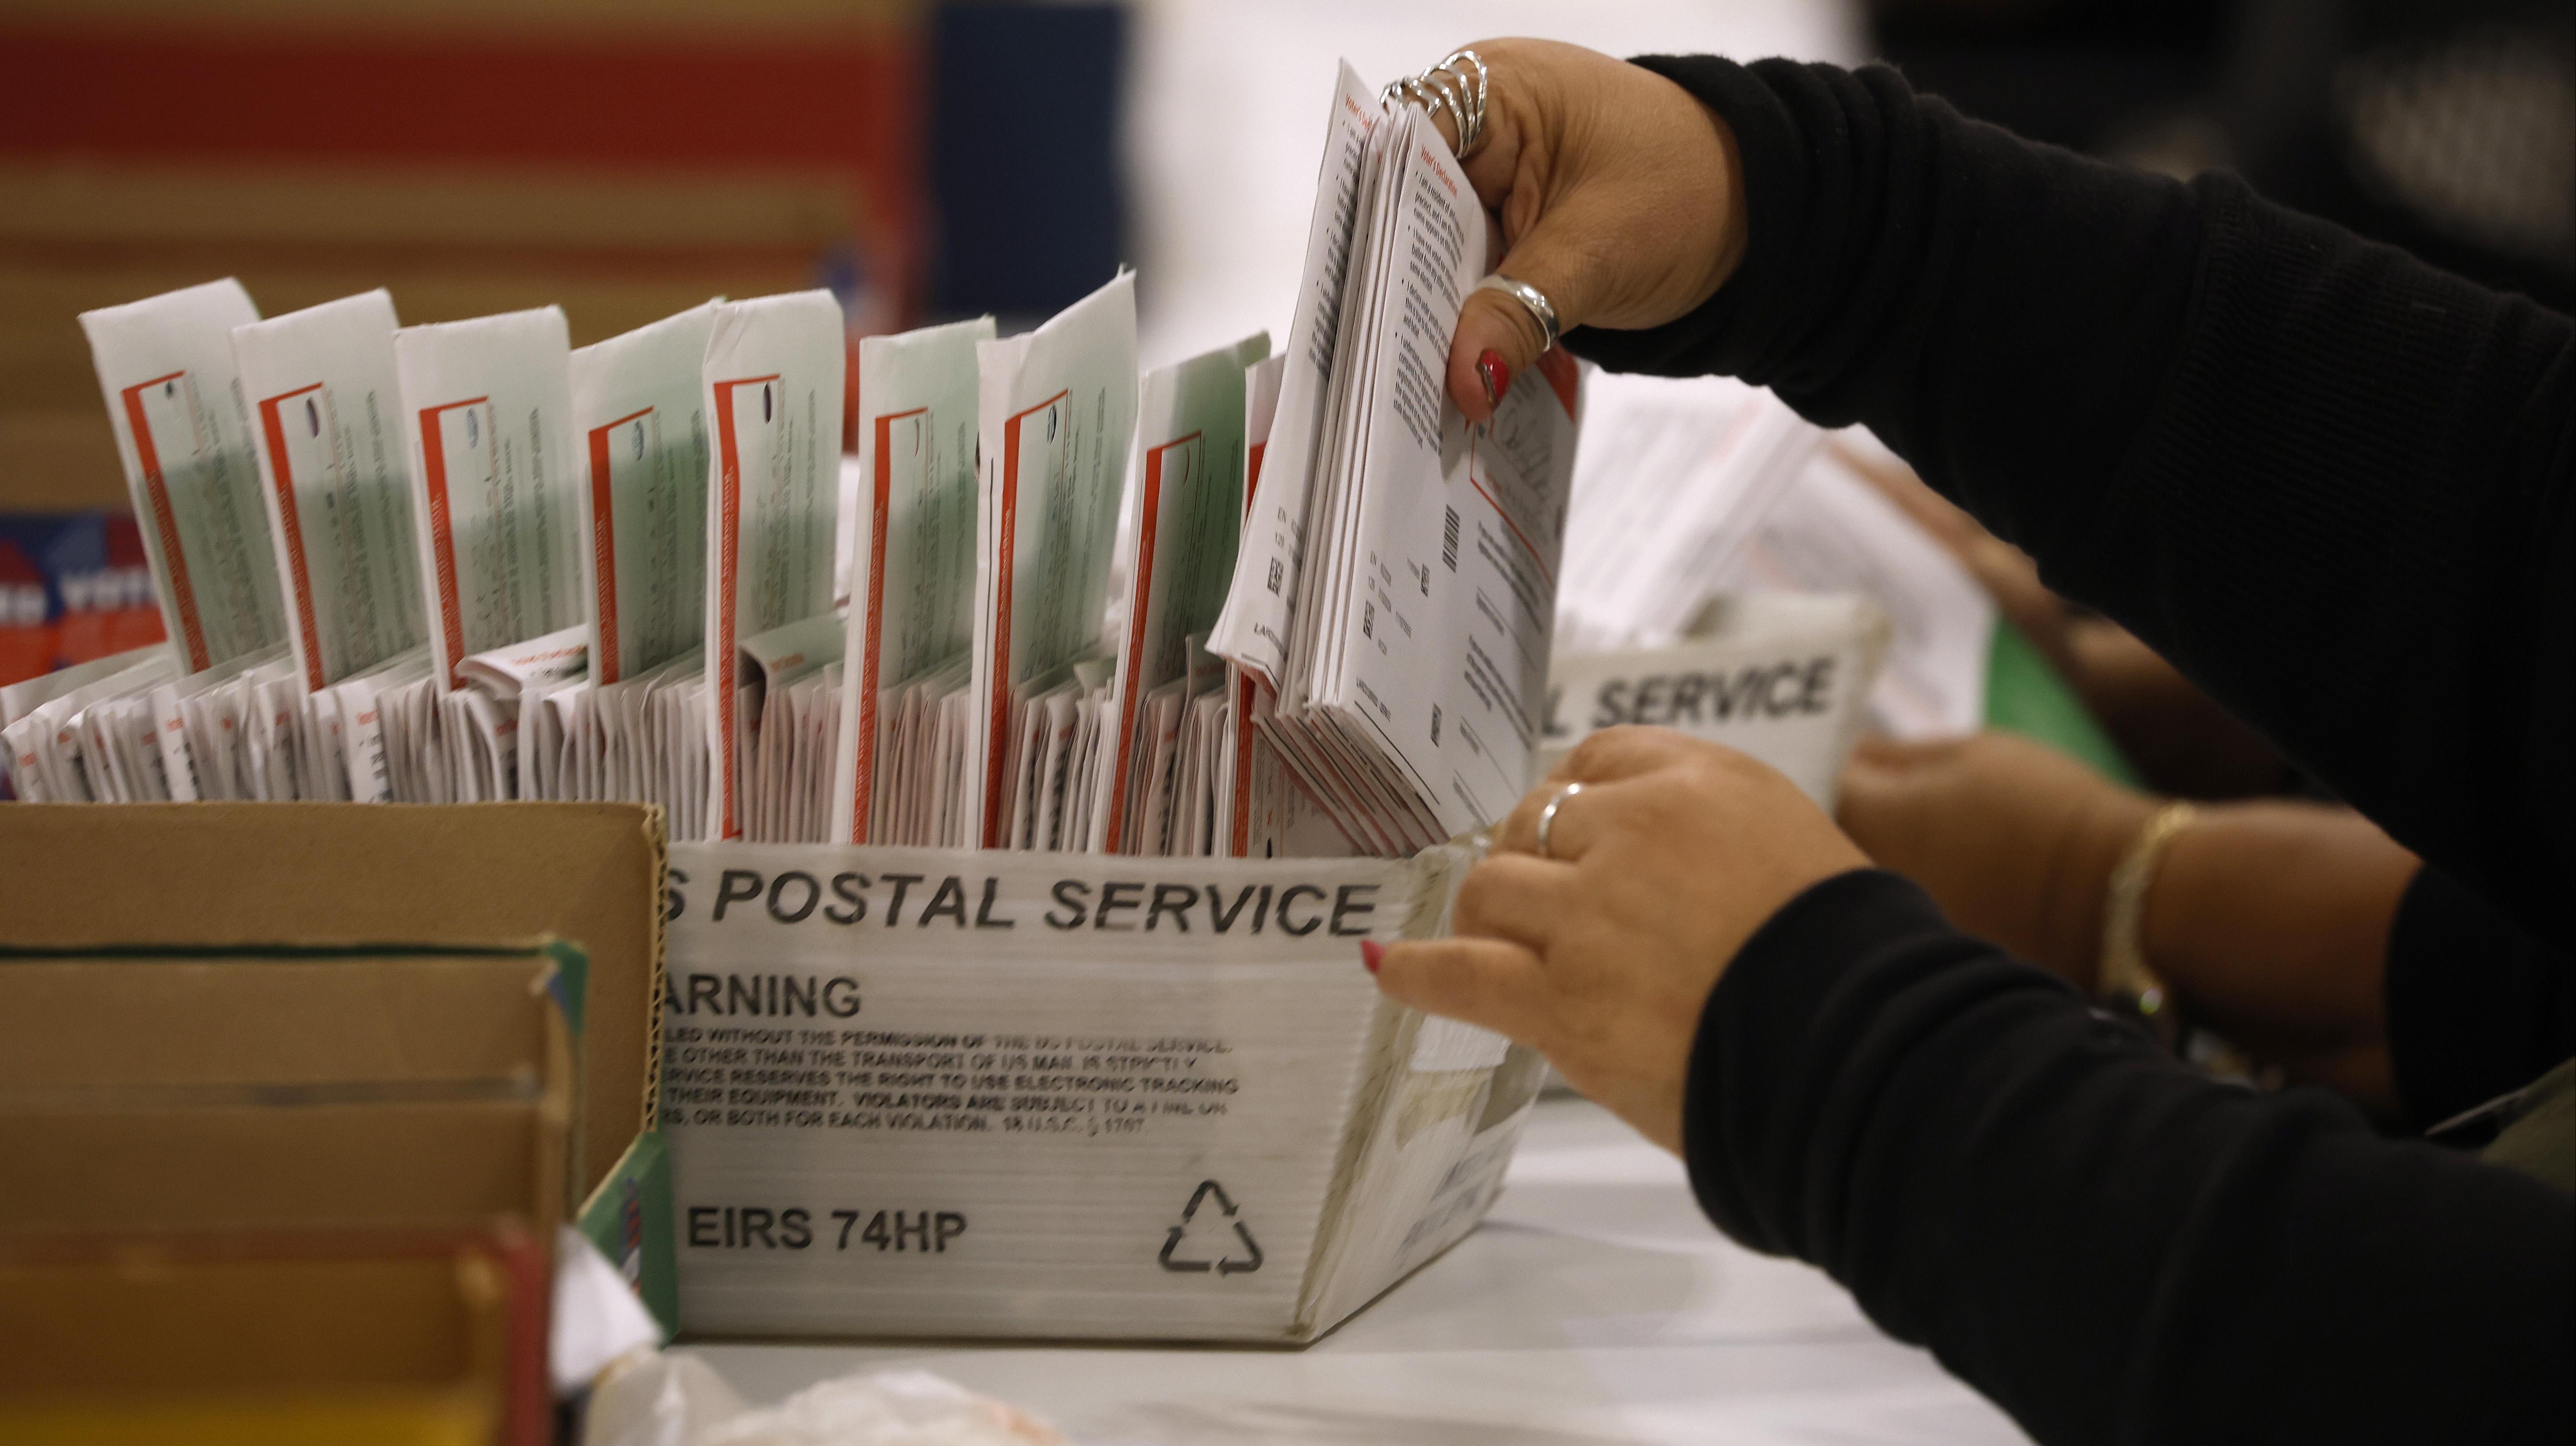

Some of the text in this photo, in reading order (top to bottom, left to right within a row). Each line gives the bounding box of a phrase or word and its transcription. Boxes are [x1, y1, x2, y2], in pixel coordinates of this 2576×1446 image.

[1421, 143, 1435, 172] Voter's
[1421, 178, 1428, 191] am
[1430, 187, 1446, 209] resident
[1445, 203, 1450, 215] of
[1415, 192, 1432, 216] precinct,
[1432, 209, 1440, 223] and
[1441, 219, 1447, 232] am
[1411, 243, 1424, 264] ballot
[1423, 253, 1432, 272] from
[1409, 284, 1422, 306] declare
[1421, 300, 1430, 315] under
[1403, 314, 1412, 329] and
[1399, 353, 1415, 377] compared
[1593, 656, 1835, 729] SERVICE
[712, 869, 1015, 928] POSTAL
[1045, 880, 1381, 936] SERVICE
[708, 1028, 793, 1044] WITHOUT
[799, 1030, 835, 1046] THE
[841, 1031, 957, 1048] PERMISSION
[682, 1047, 747, 1064] OTHER
[753, 1048, 804, 1066] THAN
[809, 1050, 844, 1067] THE
[852, 1051, 964, 1069] TRANSPORT
[731, 1069, 832, 1086] RESERVES
[835, 1071, 872, 1087] THE
[877, 1072, 935, 1088] RIGHT
[940, 1074, 966, 1089] TO
[971, 1075, 1008, 1090] USE
[1014, 1075, 1133, 1093] ELECTRONIC
[1139, 1078, 1238, 1095] TRACKING
[667, 1087, 724, 1105] THEIR
[854, 1091, 961, 1109] VIOLATORS
[965, 1093, 1007, 1111] ARE
[693, 1109, 723, 1126] OR
[727, 1109, 780, 1126] BOTH
[785, 1110, 824, 1127] FOR
[828, 1111, 881, 1129] EACH
[688, 1207, 967, 1253] EIRS 74HP
